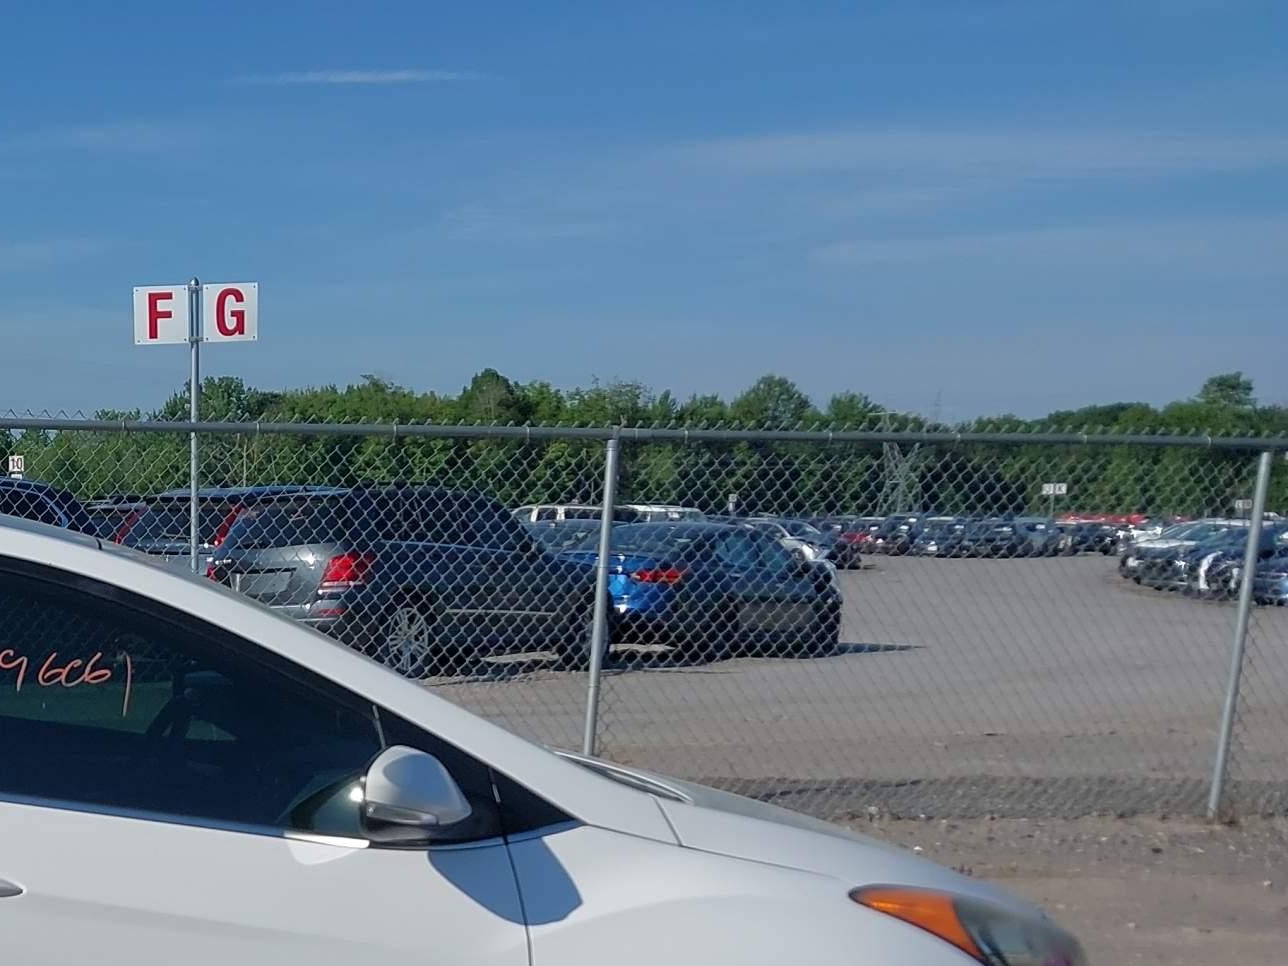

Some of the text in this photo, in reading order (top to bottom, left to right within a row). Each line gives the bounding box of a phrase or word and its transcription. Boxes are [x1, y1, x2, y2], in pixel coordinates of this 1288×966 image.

[148, 292, 173, 339] F
[216, 288, 245, 337] G
[11, 457, 23, 470] 10
